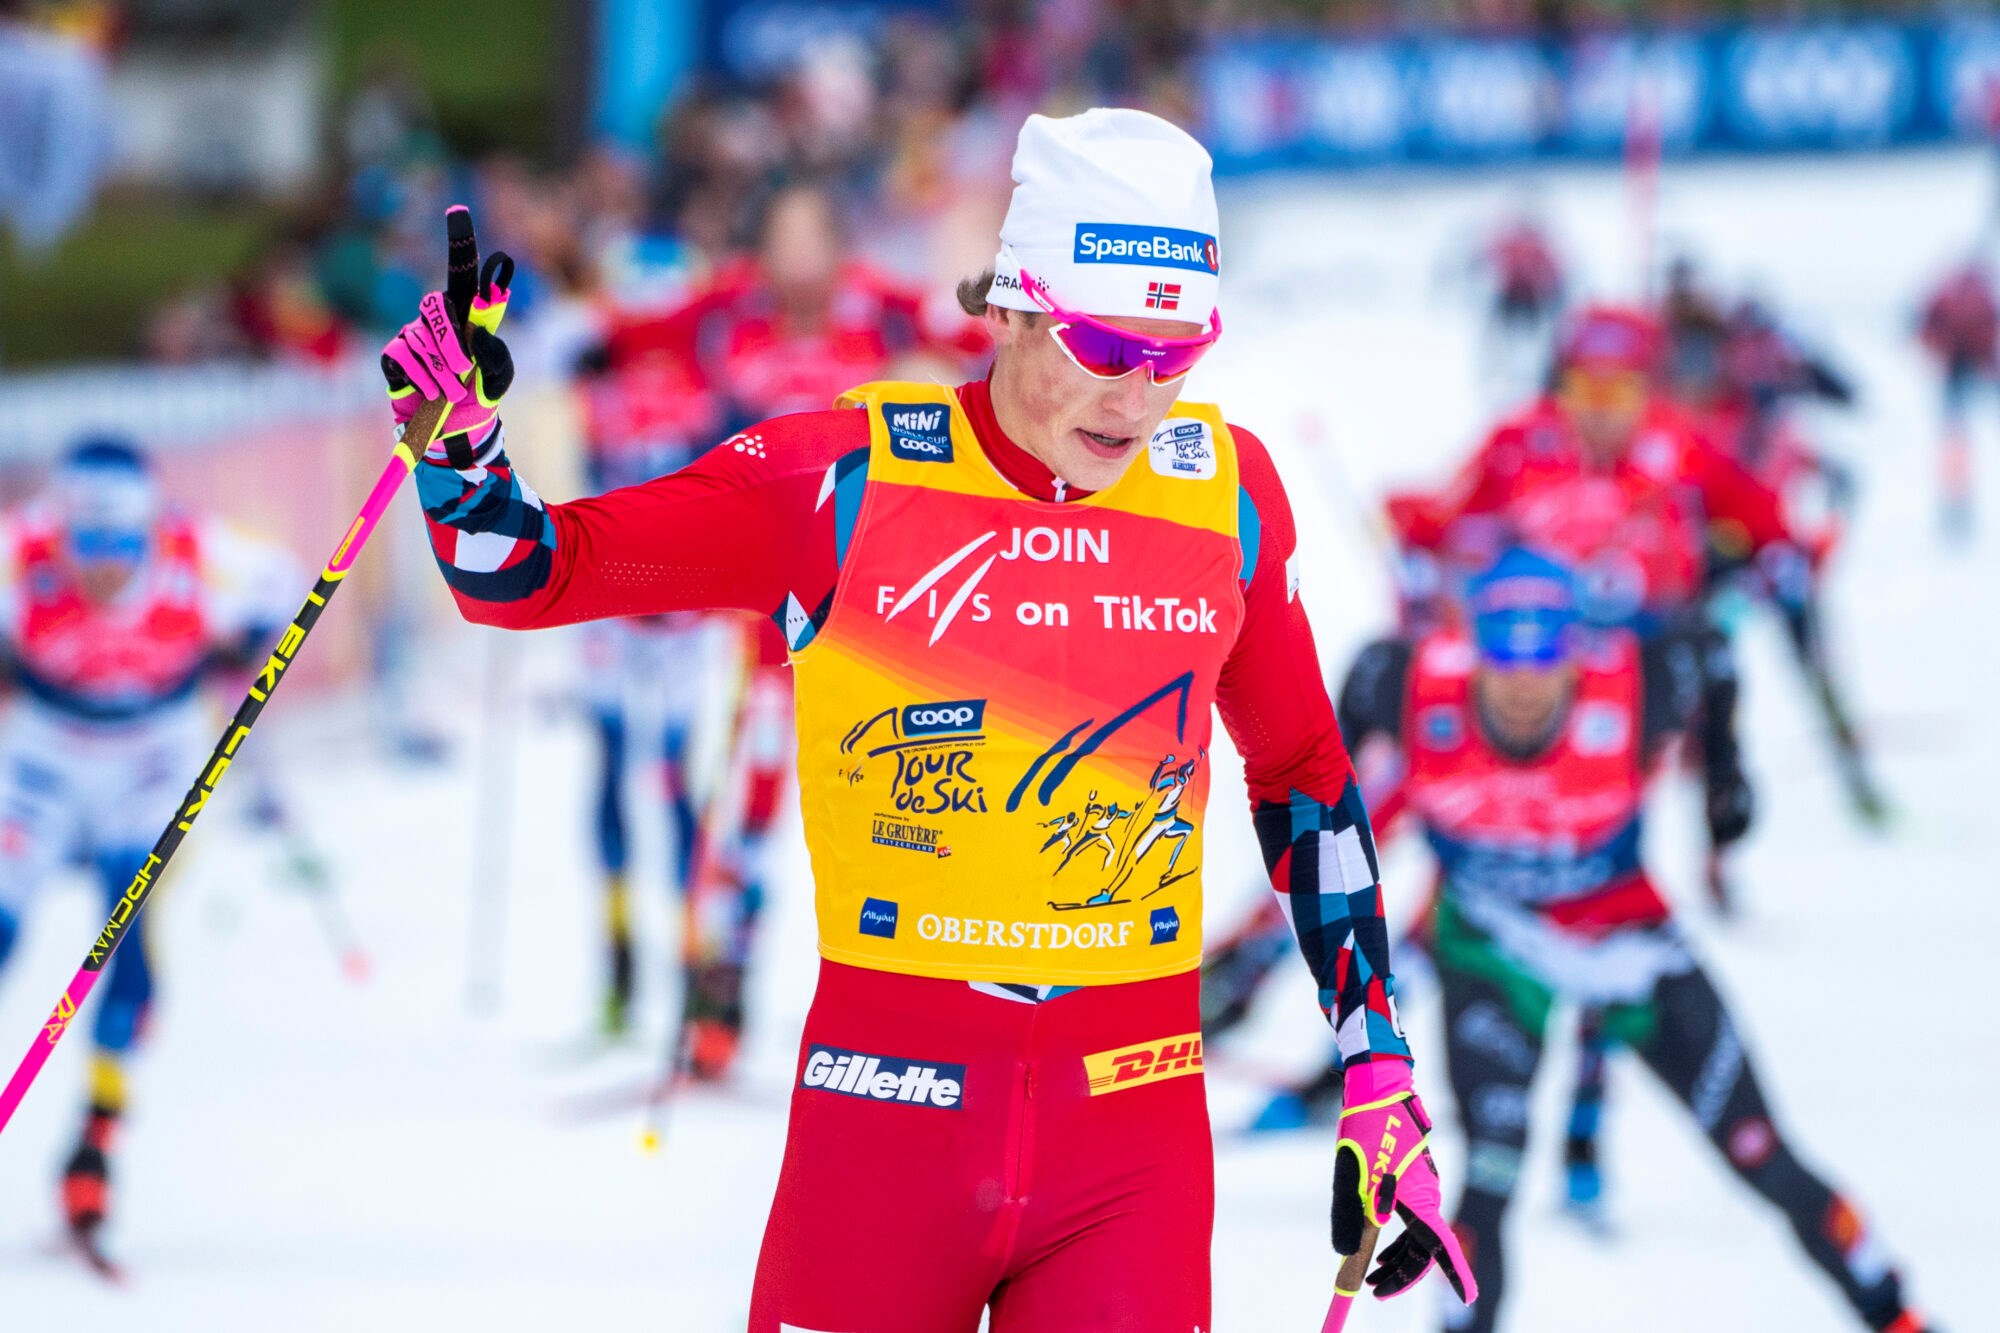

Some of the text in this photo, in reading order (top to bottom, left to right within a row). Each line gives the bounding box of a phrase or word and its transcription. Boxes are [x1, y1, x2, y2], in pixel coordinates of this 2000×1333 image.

[1080, 232, 1205, 264] SpareBank
[891, 426, 948, 445] WORLD CUP
[899, 437, 944, 454] coop
[1000, 527, 1110, 564] JOIN
[1015, 601, 1070, 626] on
[1093, 595, 1217, 634] TikTok
[910, 706, 974, 727] coop
[895, 787, 926, 814] de
[872, 820, 885, 836] LE
[873, 837, 934, 853] SWITZERLAND
[917, 914, 1134, 949] OBERSTDORF
[803, 1050, 961, 1107] Gillette
[1371, 1114, 1402, 1184] LEKI
